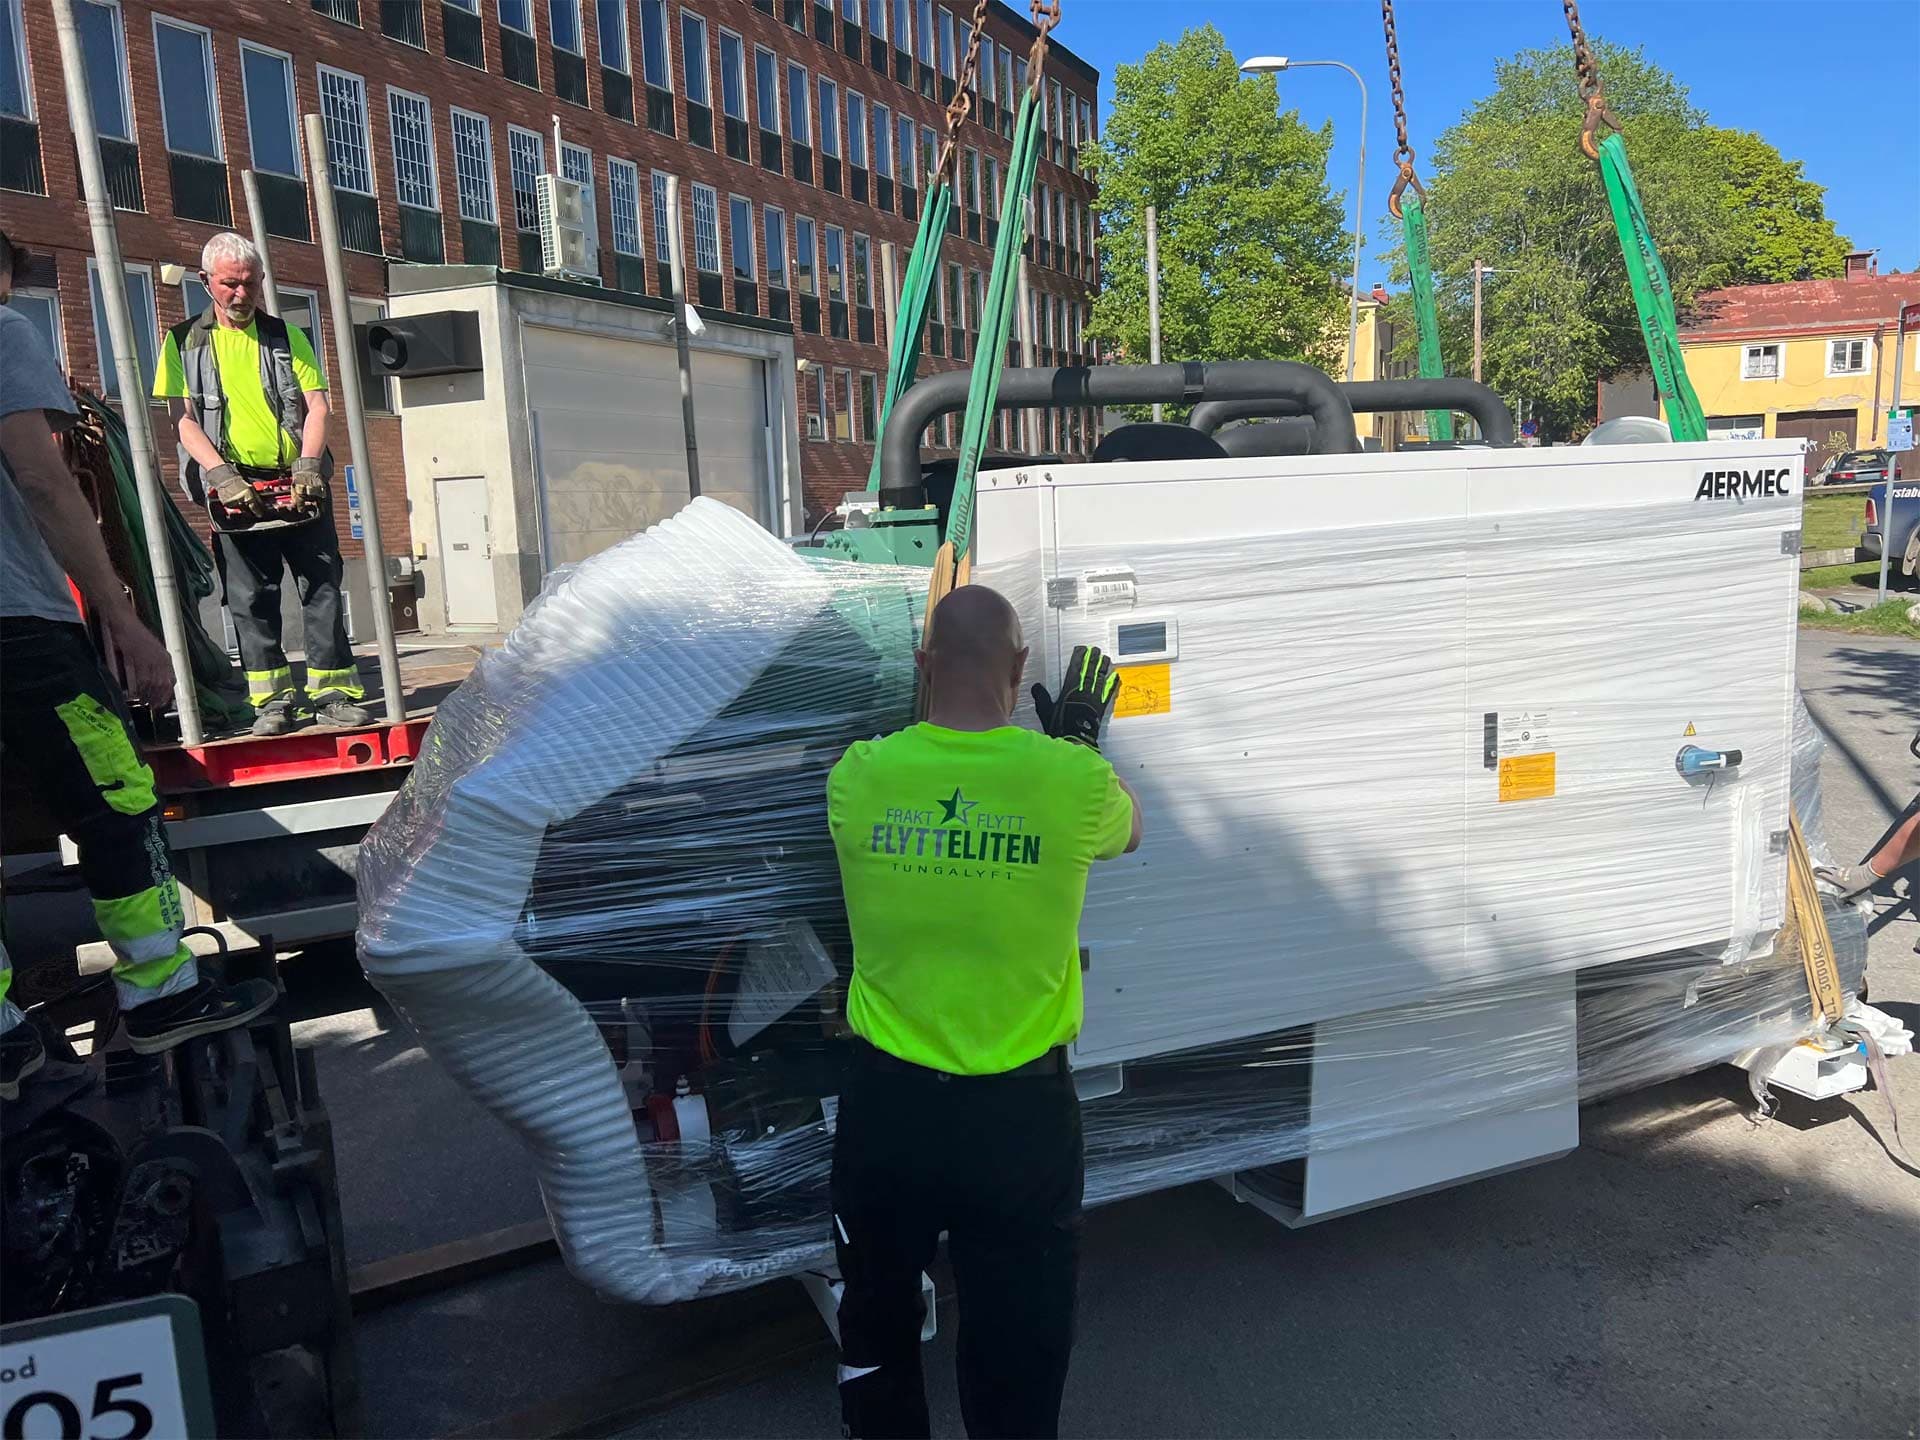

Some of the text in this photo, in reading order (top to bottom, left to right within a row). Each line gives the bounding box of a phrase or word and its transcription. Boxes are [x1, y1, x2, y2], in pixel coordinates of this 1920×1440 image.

[1645, 314, 1661, 347] WLL
[1693, 468, 1790, 505] AERMEC
[885, 808, 1026, 831] FRAKT FLYTT
[871, 823, 1041, 865] FLYTTELITEN
[892, 863, 1014, 880] TUNGALYFT
